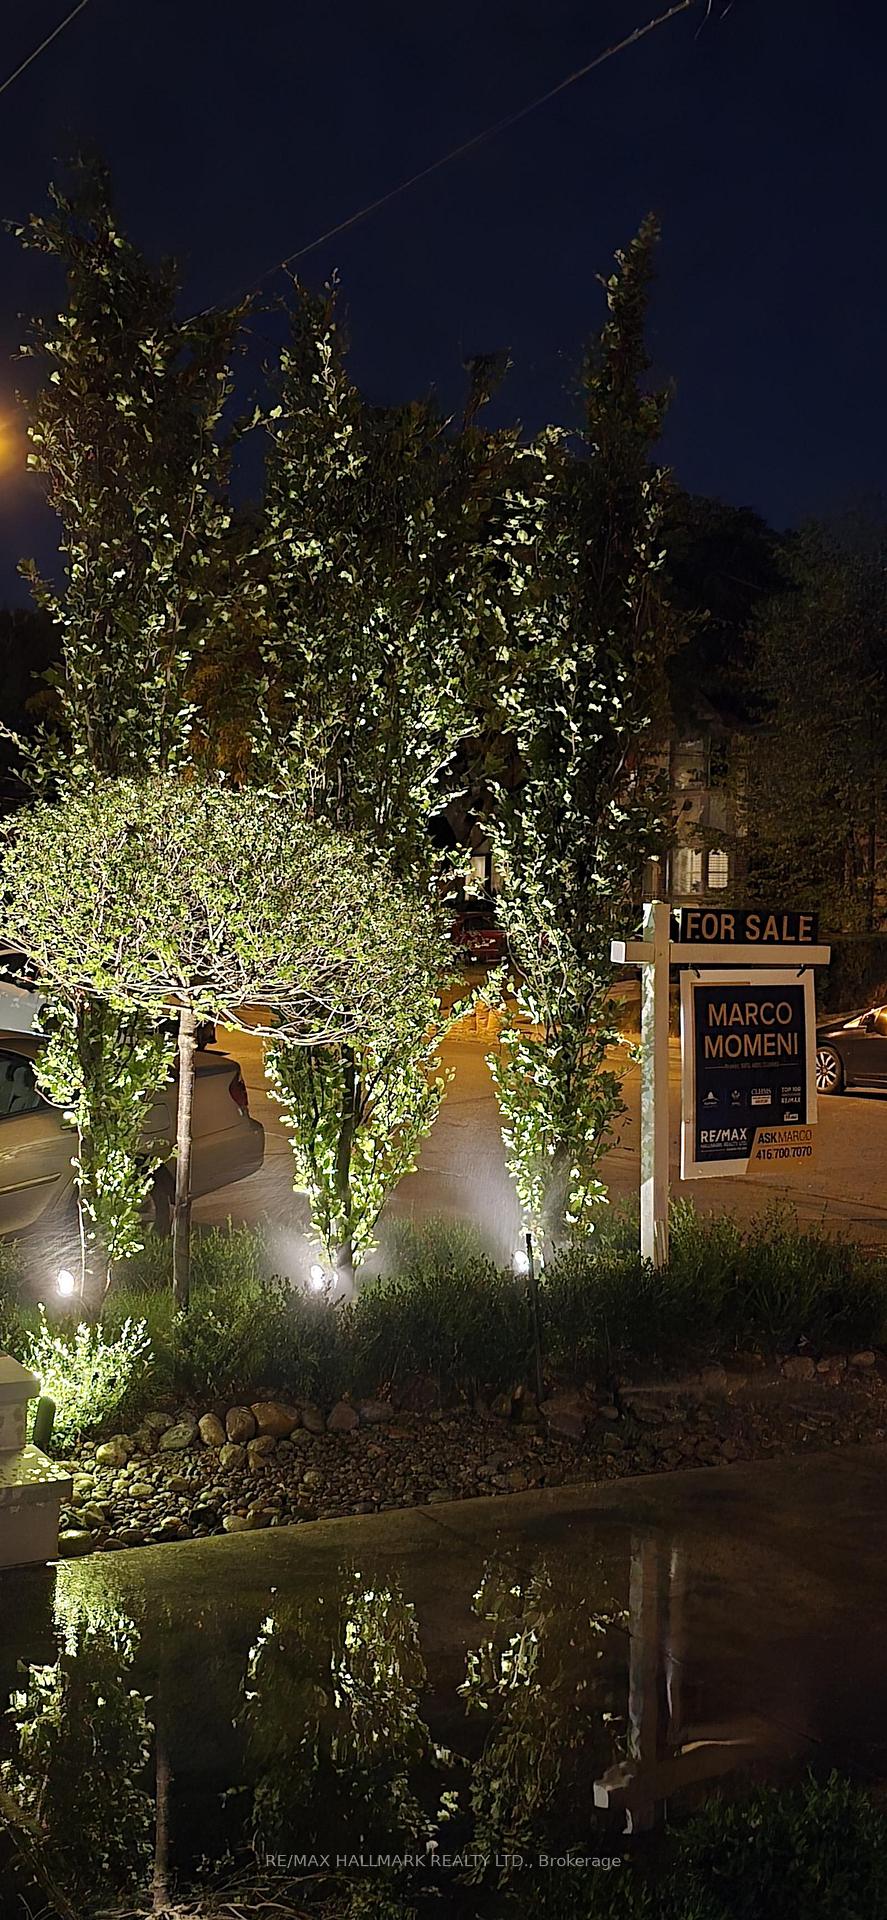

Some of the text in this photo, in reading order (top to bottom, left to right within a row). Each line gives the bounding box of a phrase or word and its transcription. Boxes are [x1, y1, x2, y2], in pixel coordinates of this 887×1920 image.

[686, 912, 813, 942] FOR SALE
[708, 1001, 793, 1027] MARCO
[704, 1032, 798, 1059] MOMENI
[700, 1127, 748, 1143] RE/MAX
[755, 1146, 813, 1161] 416.700.7070
